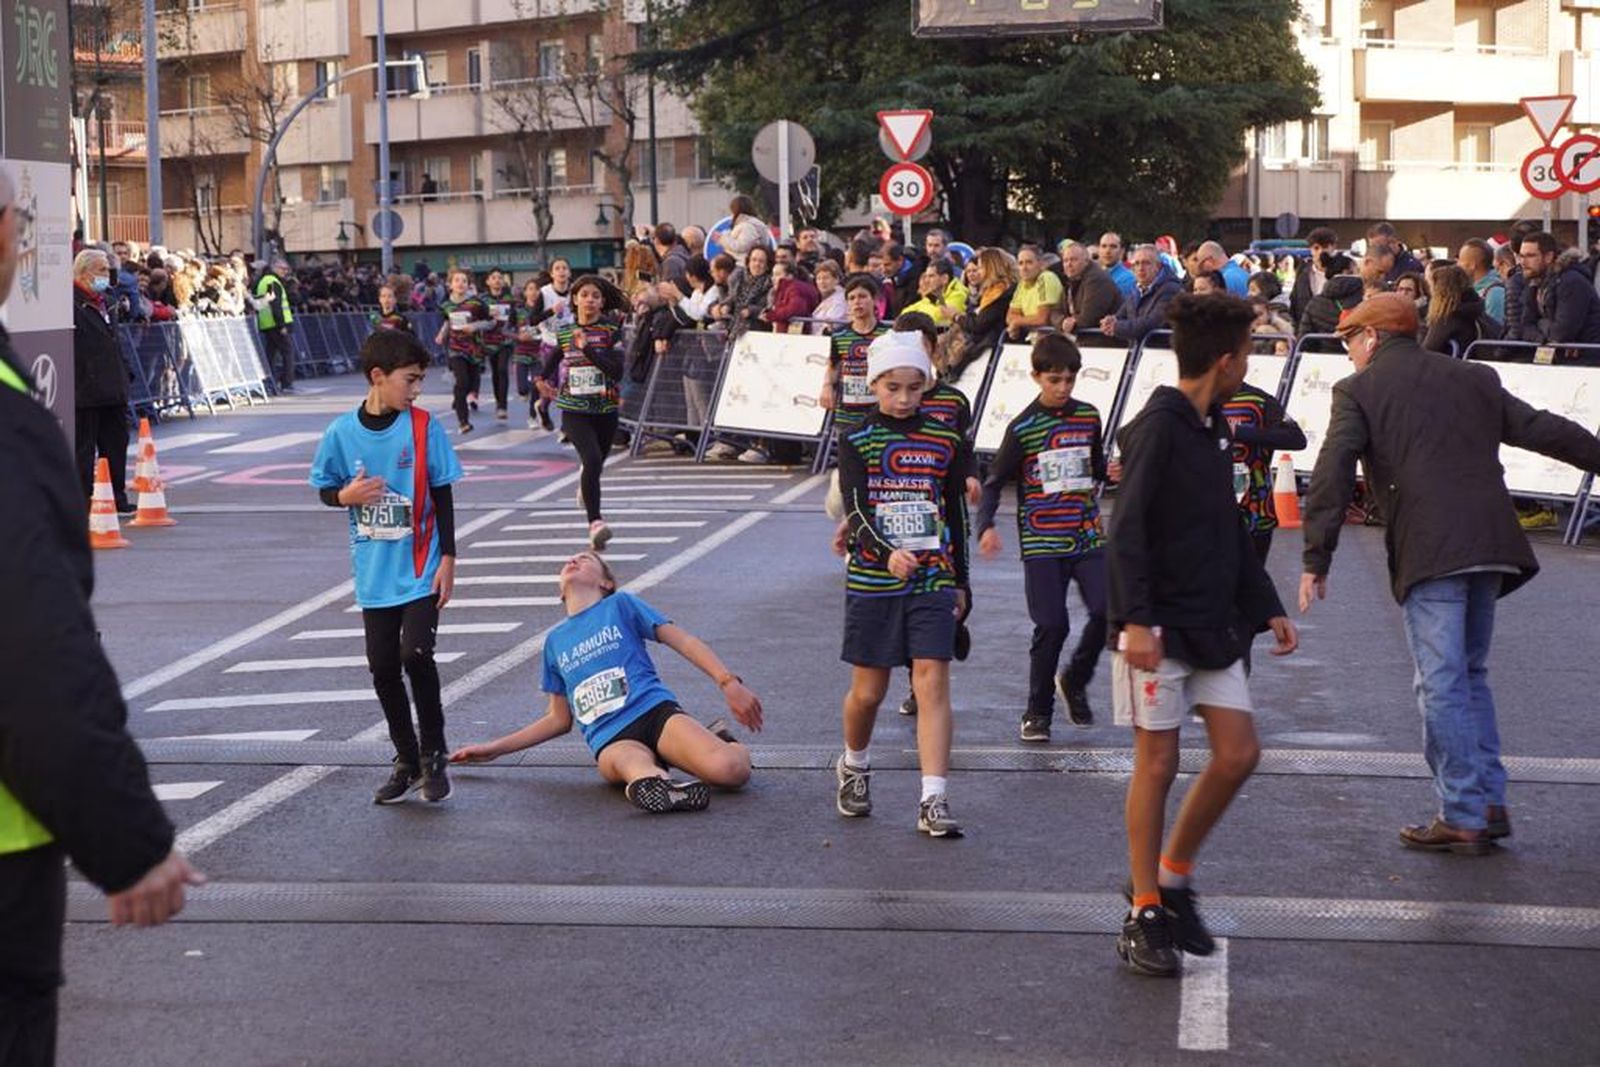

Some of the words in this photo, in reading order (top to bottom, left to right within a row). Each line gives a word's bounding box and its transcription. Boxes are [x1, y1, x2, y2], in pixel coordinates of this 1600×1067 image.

[892, 181, 919, 197] 30
[362, 504, 394, 524] 5751
[883, 514, 926, 535] 5868
[571, 625, 623, 660] ARMUÑA
